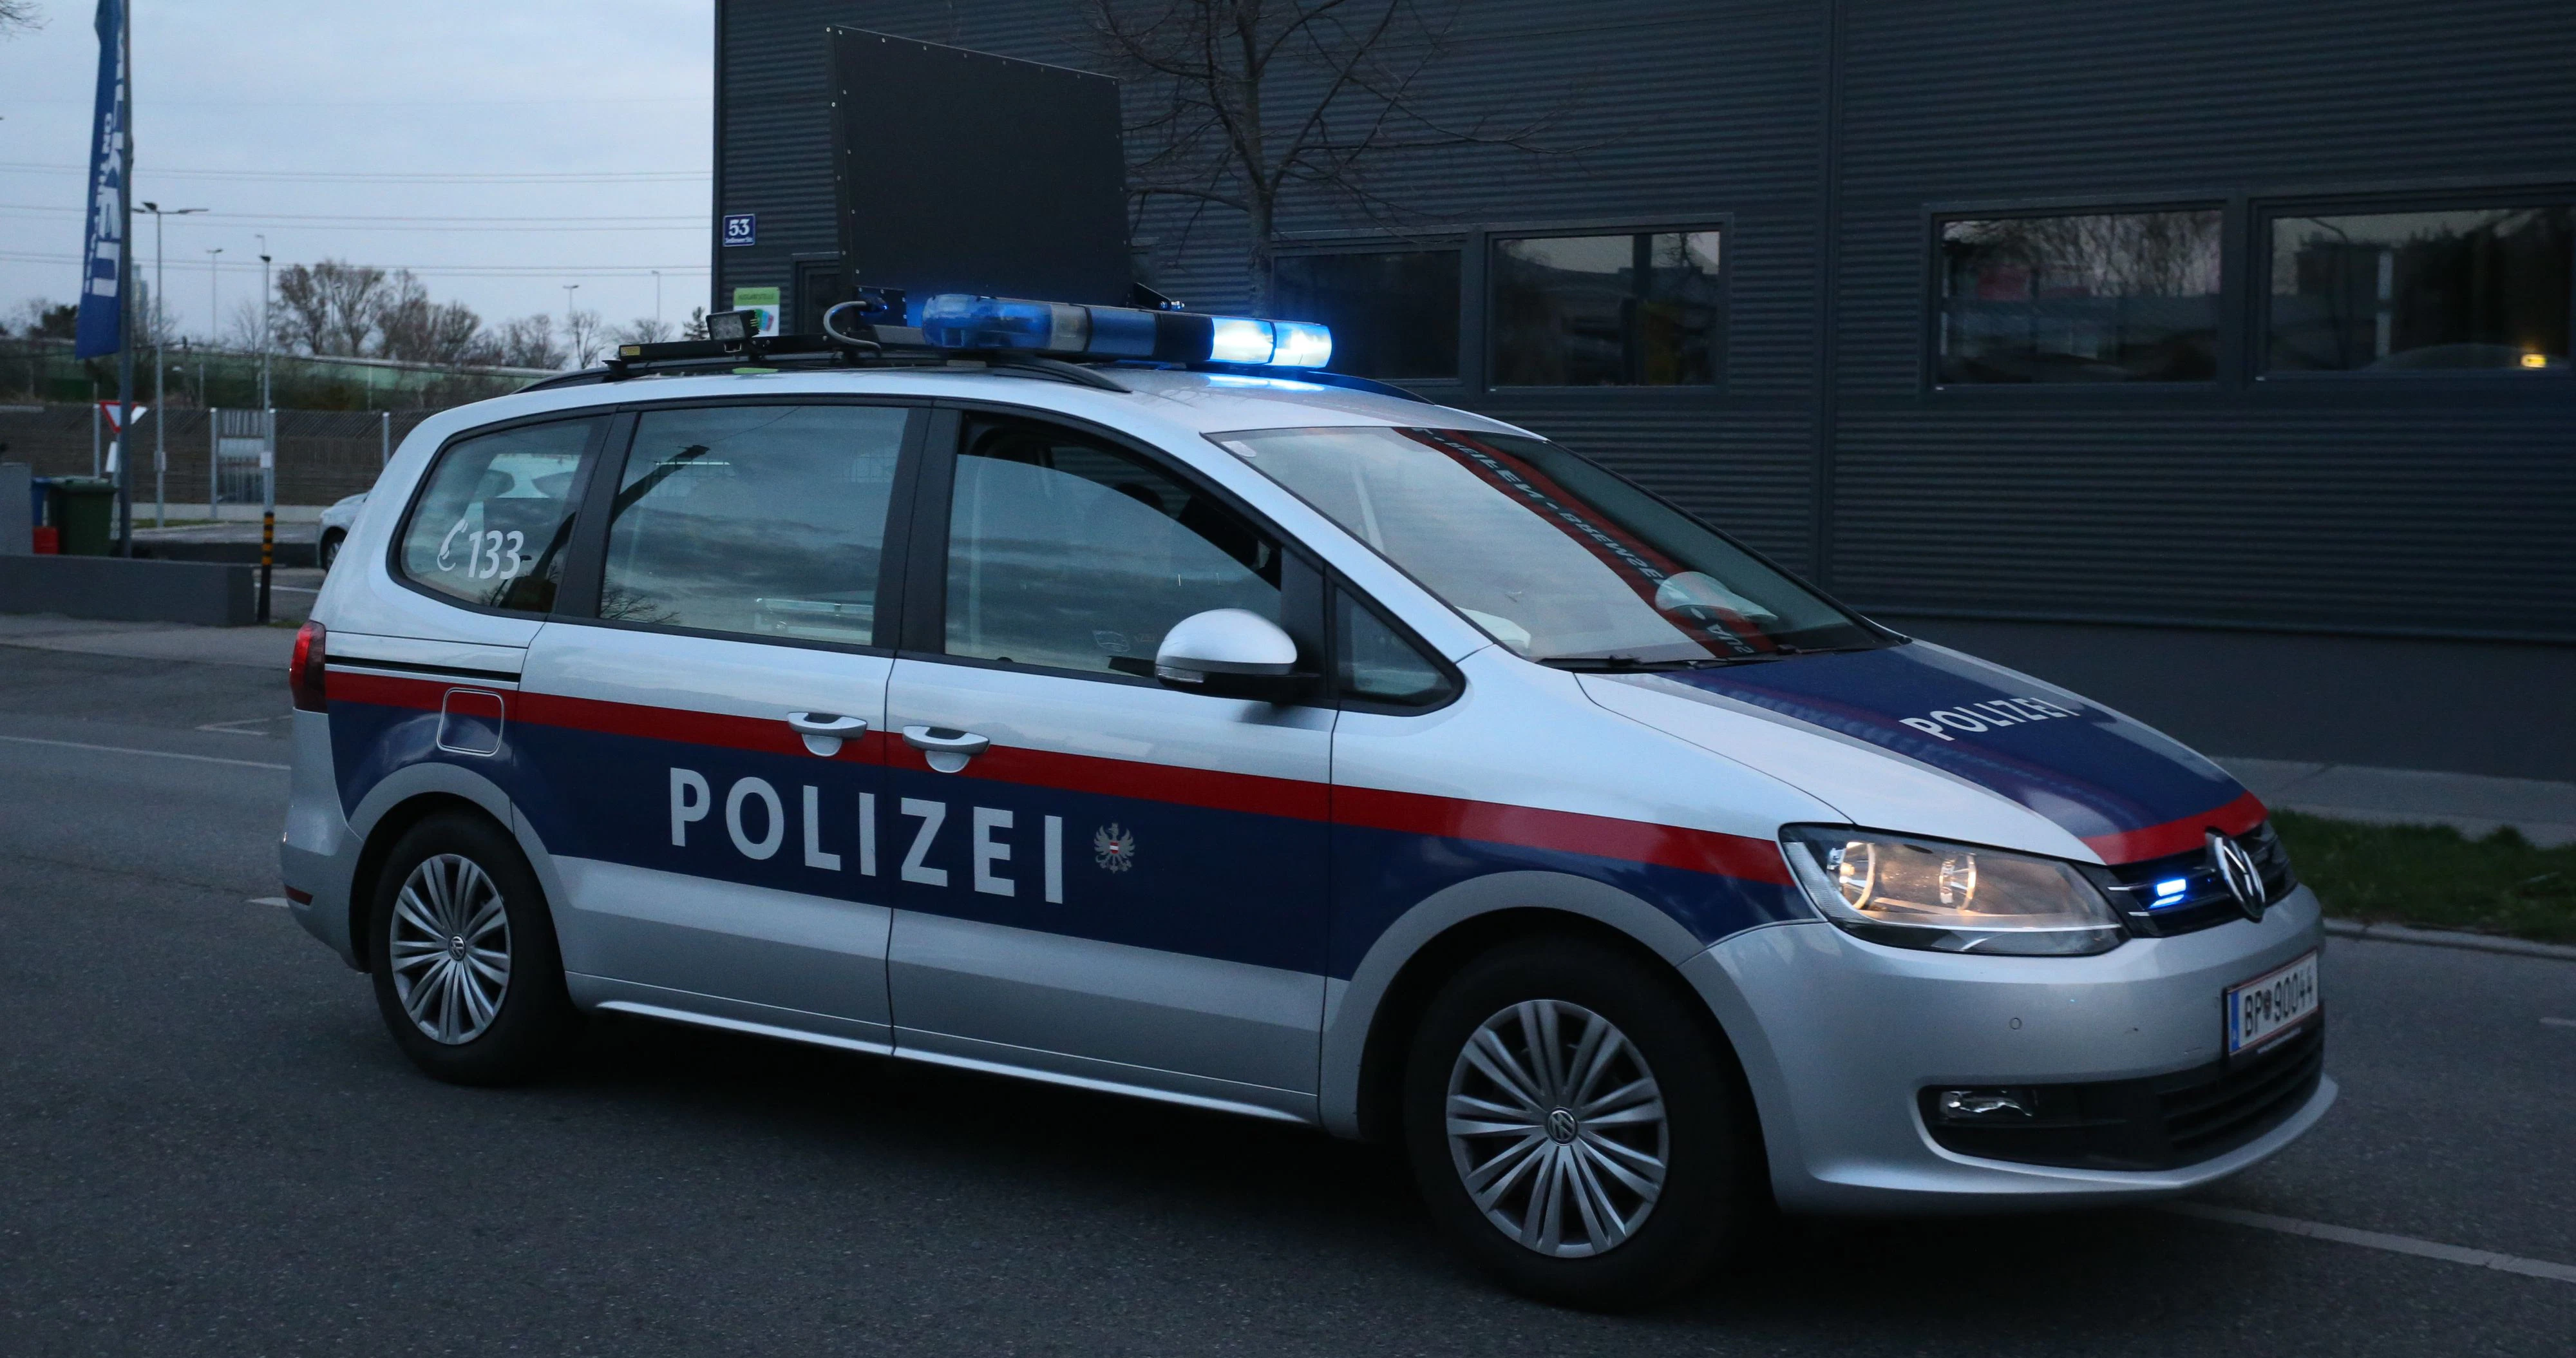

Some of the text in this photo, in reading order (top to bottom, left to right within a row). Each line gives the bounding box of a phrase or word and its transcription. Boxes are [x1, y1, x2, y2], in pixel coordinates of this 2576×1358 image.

[728, 218, 750, 236] 53
[468, 530, 524, 580] 133
[1898, 697, 2081, 741] POLIZEI
[670, 767, 1063, 904] POLIZEI
[2244, 990, 2262, 1038] BP
